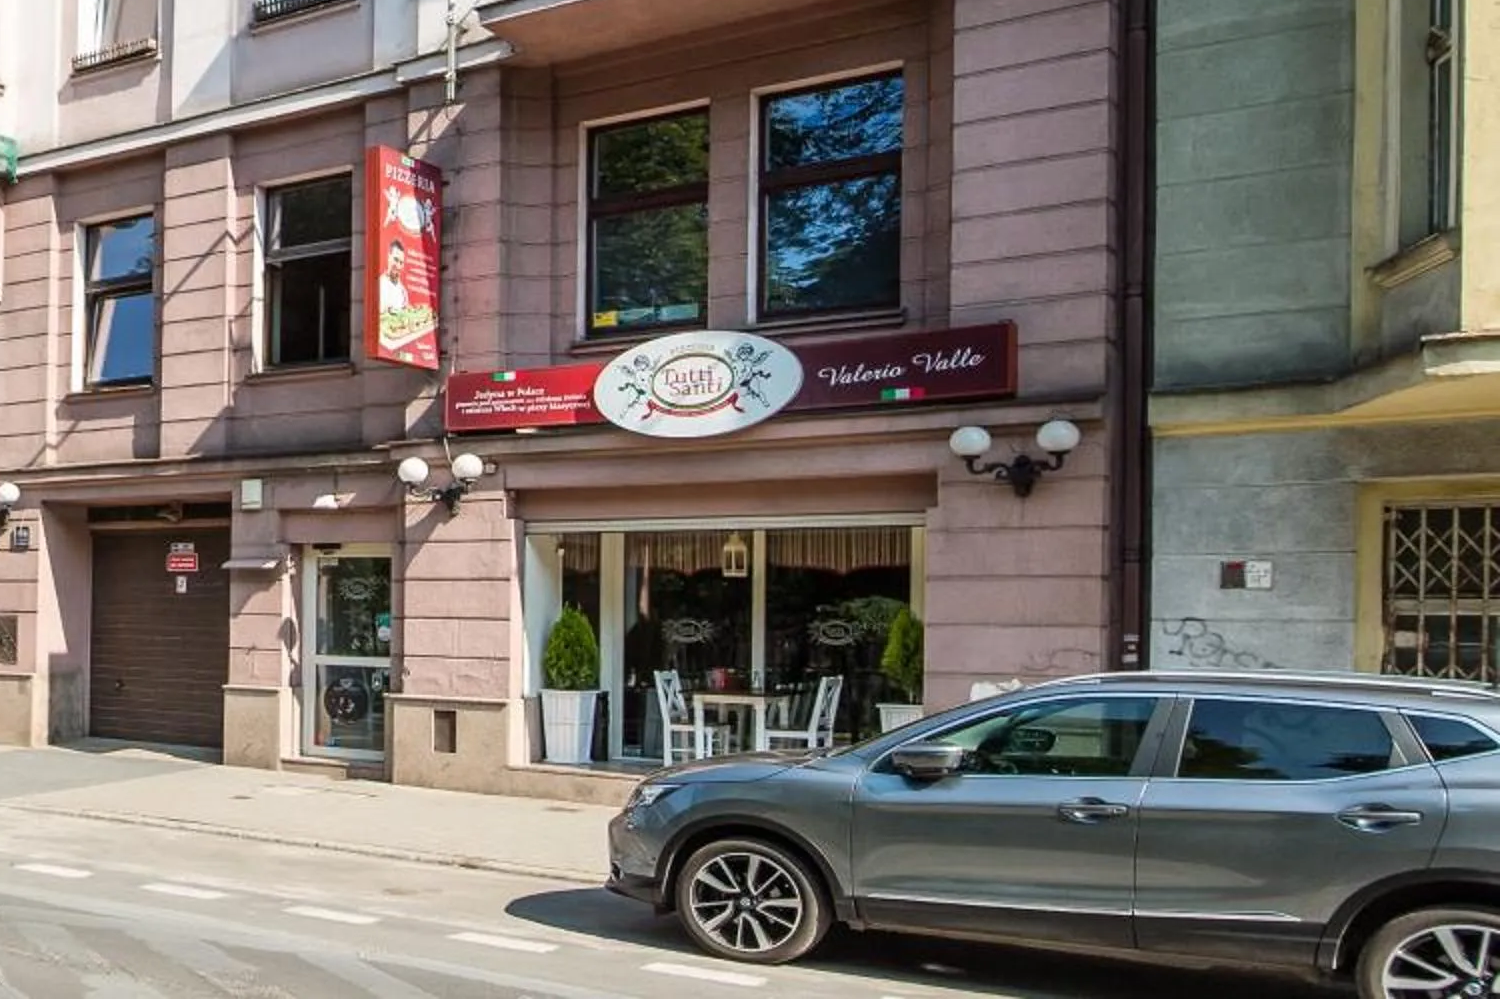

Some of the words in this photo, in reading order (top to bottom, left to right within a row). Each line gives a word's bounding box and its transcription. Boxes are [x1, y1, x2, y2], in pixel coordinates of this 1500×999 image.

[663, 365, 714, 385] Tutti
[818, 362, 906, 387] Valerio
[911, 346, 986, 374] Valle
[670, 377, 723, 397] Santi
